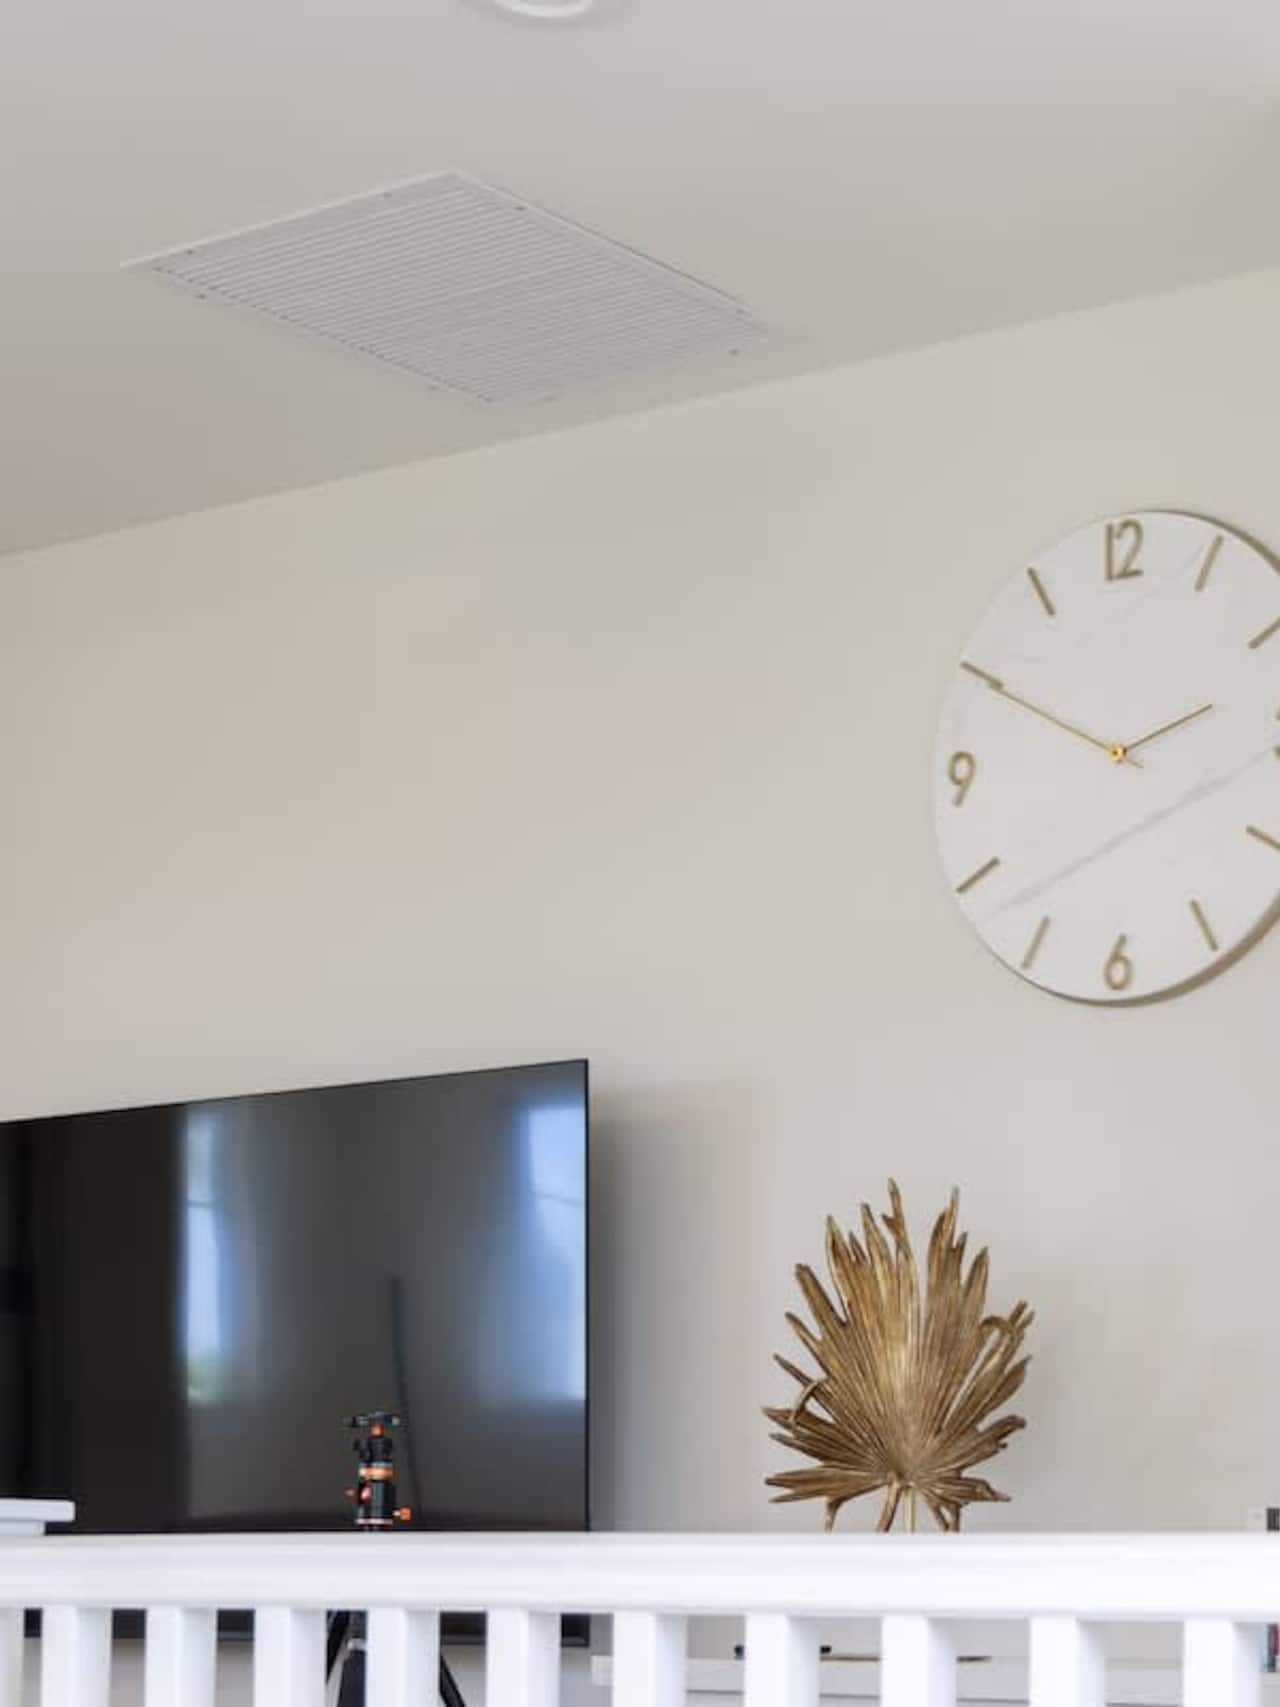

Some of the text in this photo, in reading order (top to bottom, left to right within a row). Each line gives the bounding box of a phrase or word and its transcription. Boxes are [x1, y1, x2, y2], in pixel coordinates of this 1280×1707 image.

[1104, 518, 1143, 581] 12
[947, 750, 975, 806] 9
[1103, 933, 1133, 990] 6
